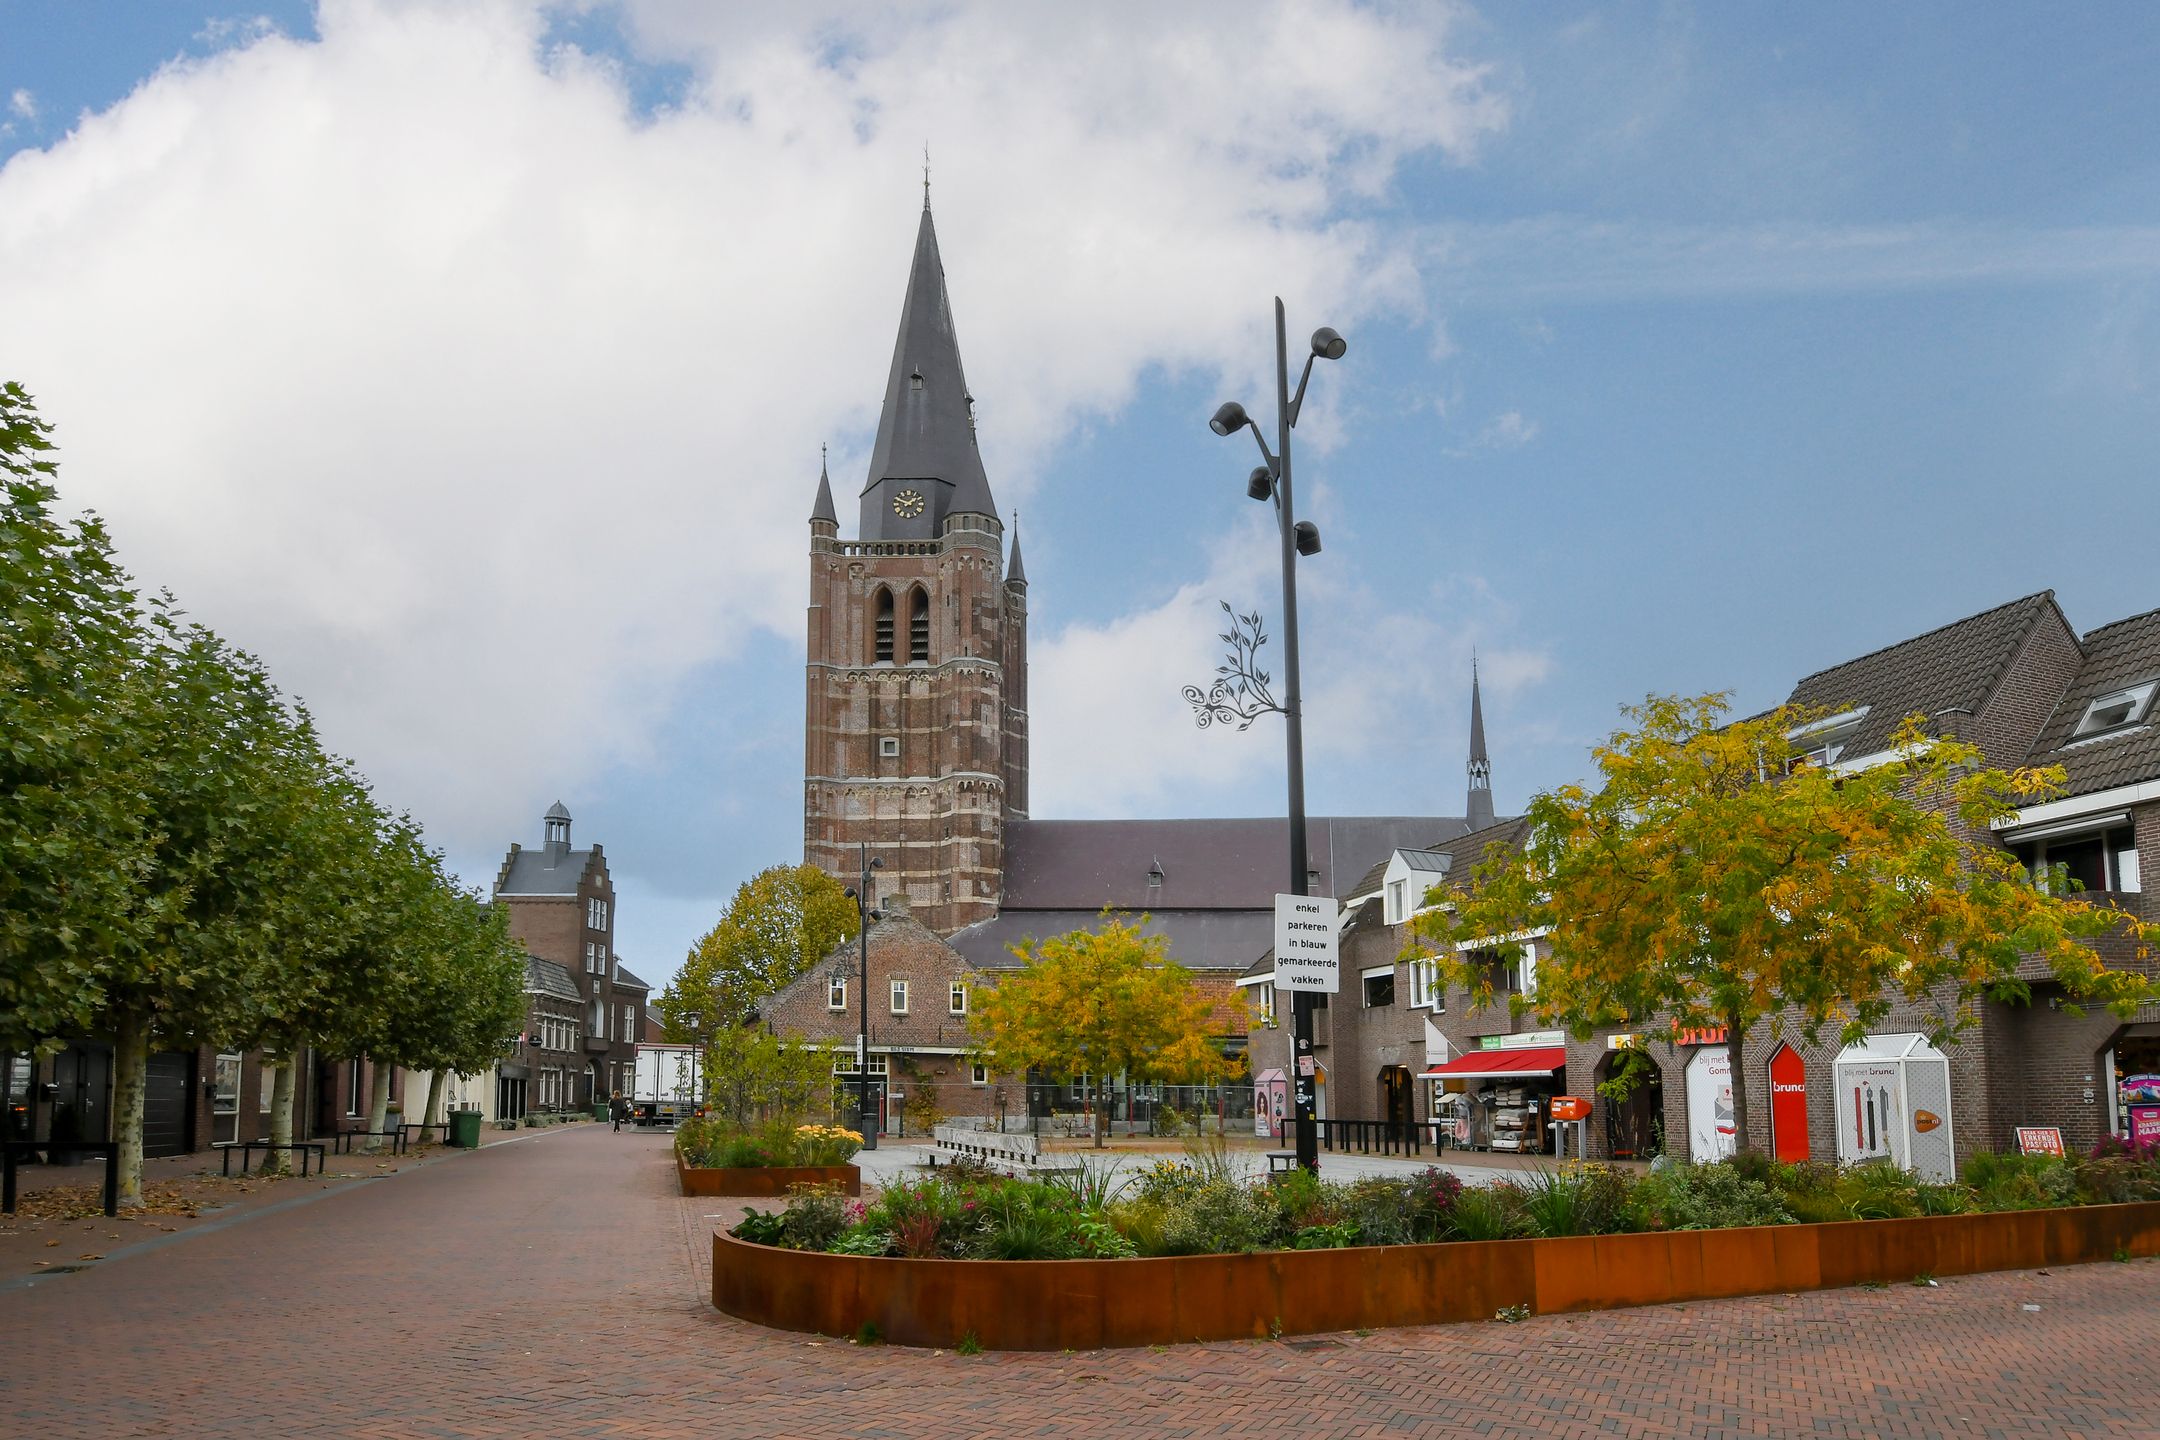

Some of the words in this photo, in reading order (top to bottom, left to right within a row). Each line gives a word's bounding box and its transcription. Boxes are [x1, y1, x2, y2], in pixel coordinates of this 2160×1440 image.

[1295, 904, 1320, 913] enkel
[1288, 921, 1328, 932] parkeren
[1289, 938, 1298, 947] in
[1300, 939, 1327, 949] blauw
[1278, 957, 1337, 968] gemarkeerde
[1291, 976, 1324, 985] vakken
[1700, 1056, 1710, 1066] blij
[1869, 1067, 1895, 1075] bruna
[1773, 1081, 1805, 1092] bruna
